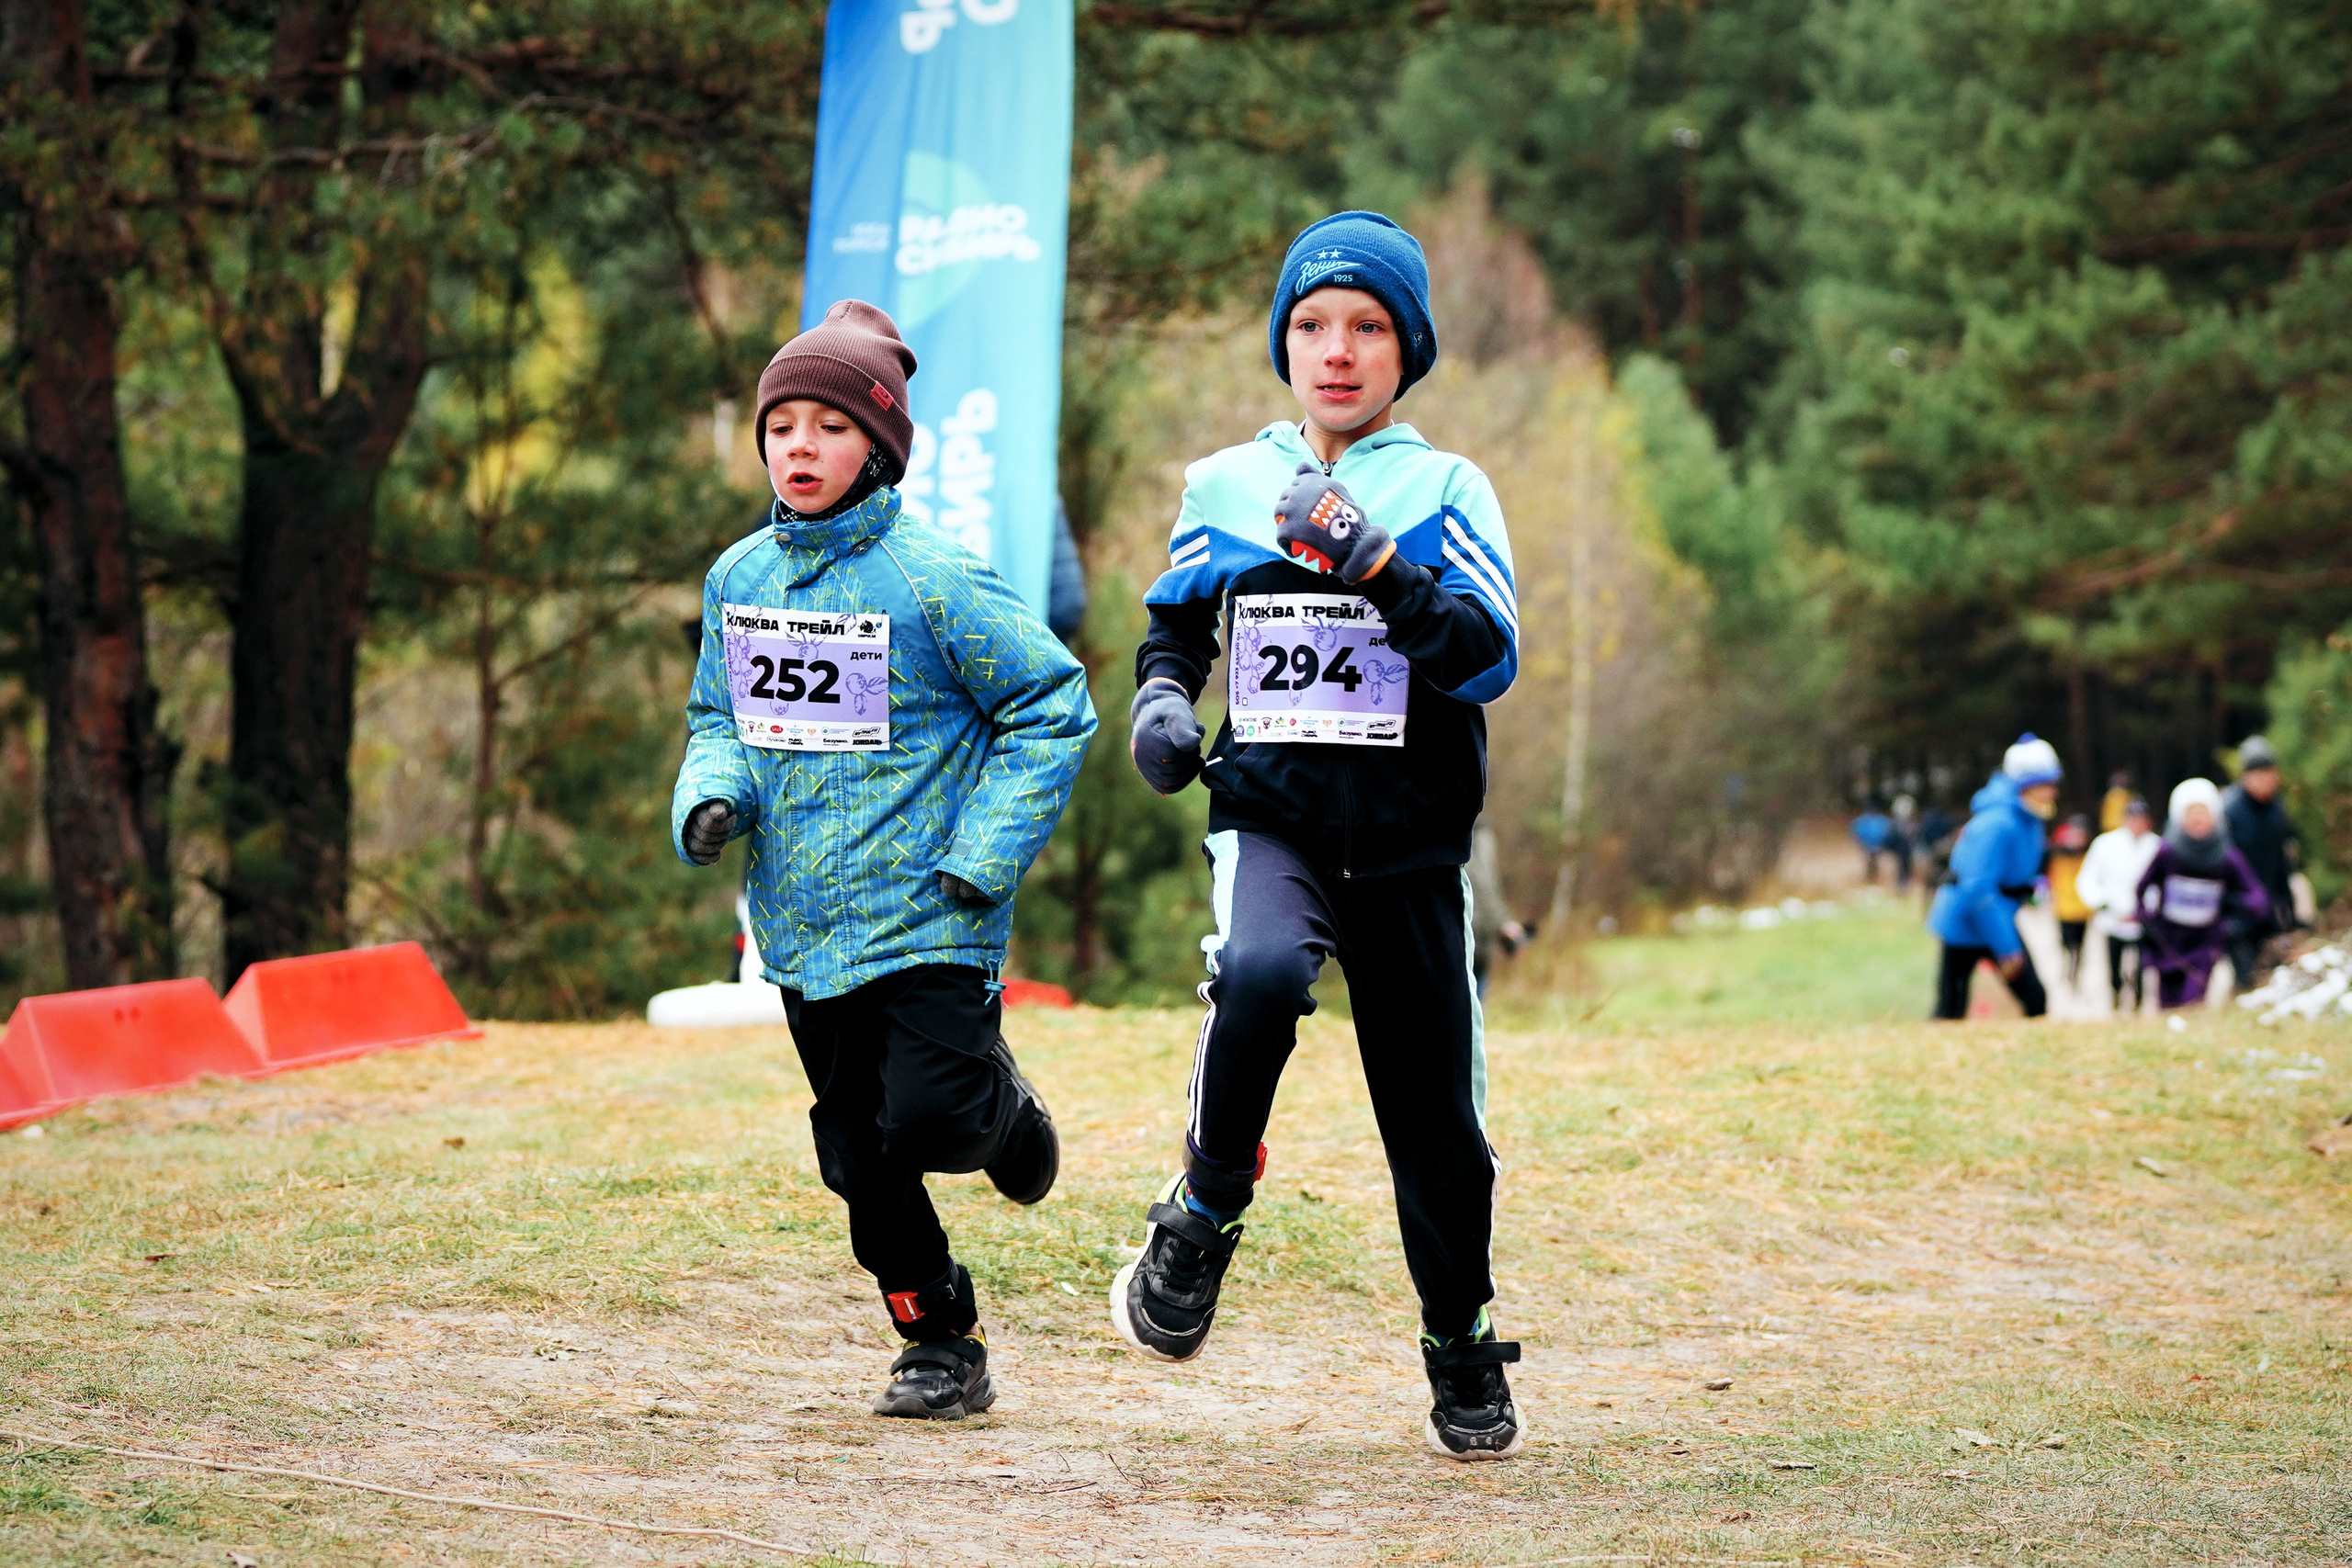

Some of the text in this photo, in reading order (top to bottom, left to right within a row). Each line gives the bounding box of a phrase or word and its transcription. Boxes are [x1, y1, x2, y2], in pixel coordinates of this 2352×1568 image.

[1333, 274, 1353, 283] 1925
[1302, 603, 1365, 620] ТРЕЙЛ
[727, 615, 845, 636] КЛЮКВА ТРЕЙЛ
[1368, 637, 1385, 647] де
[850, 651, 883, 660] дети
[1259, 645, 1363, 693] 294
[750, 655, 841, 704] 252
